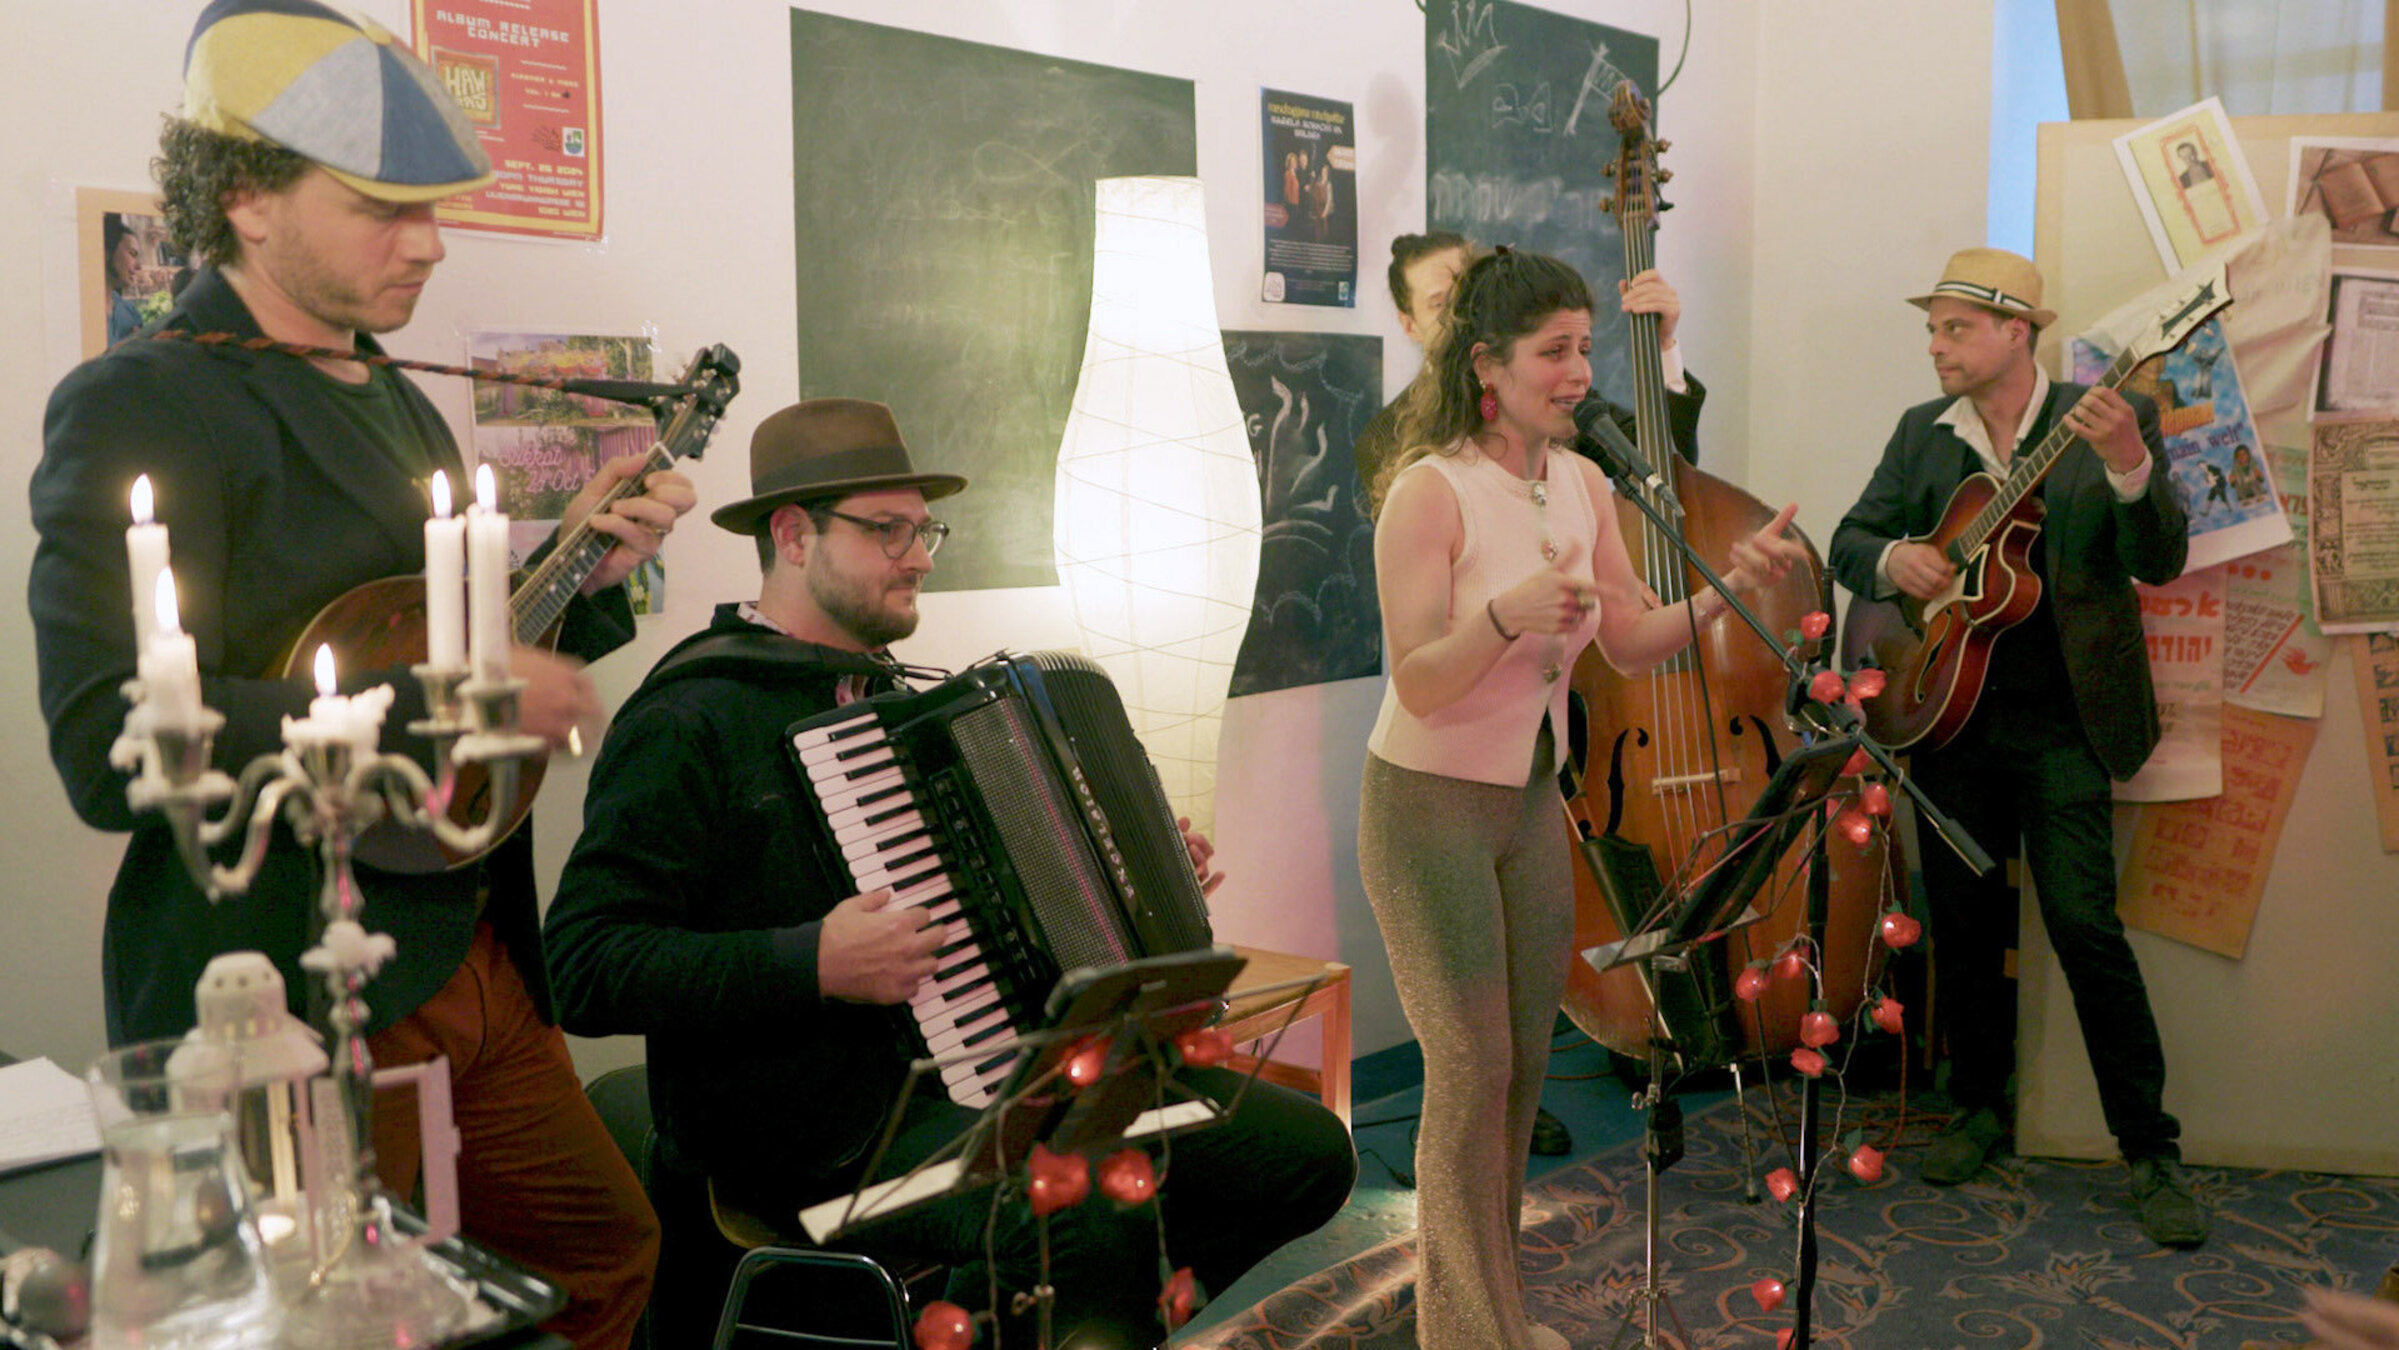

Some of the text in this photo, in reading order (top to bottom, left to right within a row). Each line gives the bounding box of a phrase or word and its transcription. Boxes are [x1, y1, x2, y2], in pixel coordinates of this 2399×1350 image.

[436, 9, 569, 43] ALBUM RELEASE
[467, 26, 540, 48] CONCERT
[527, 173, 583, 188] THURSDAY
